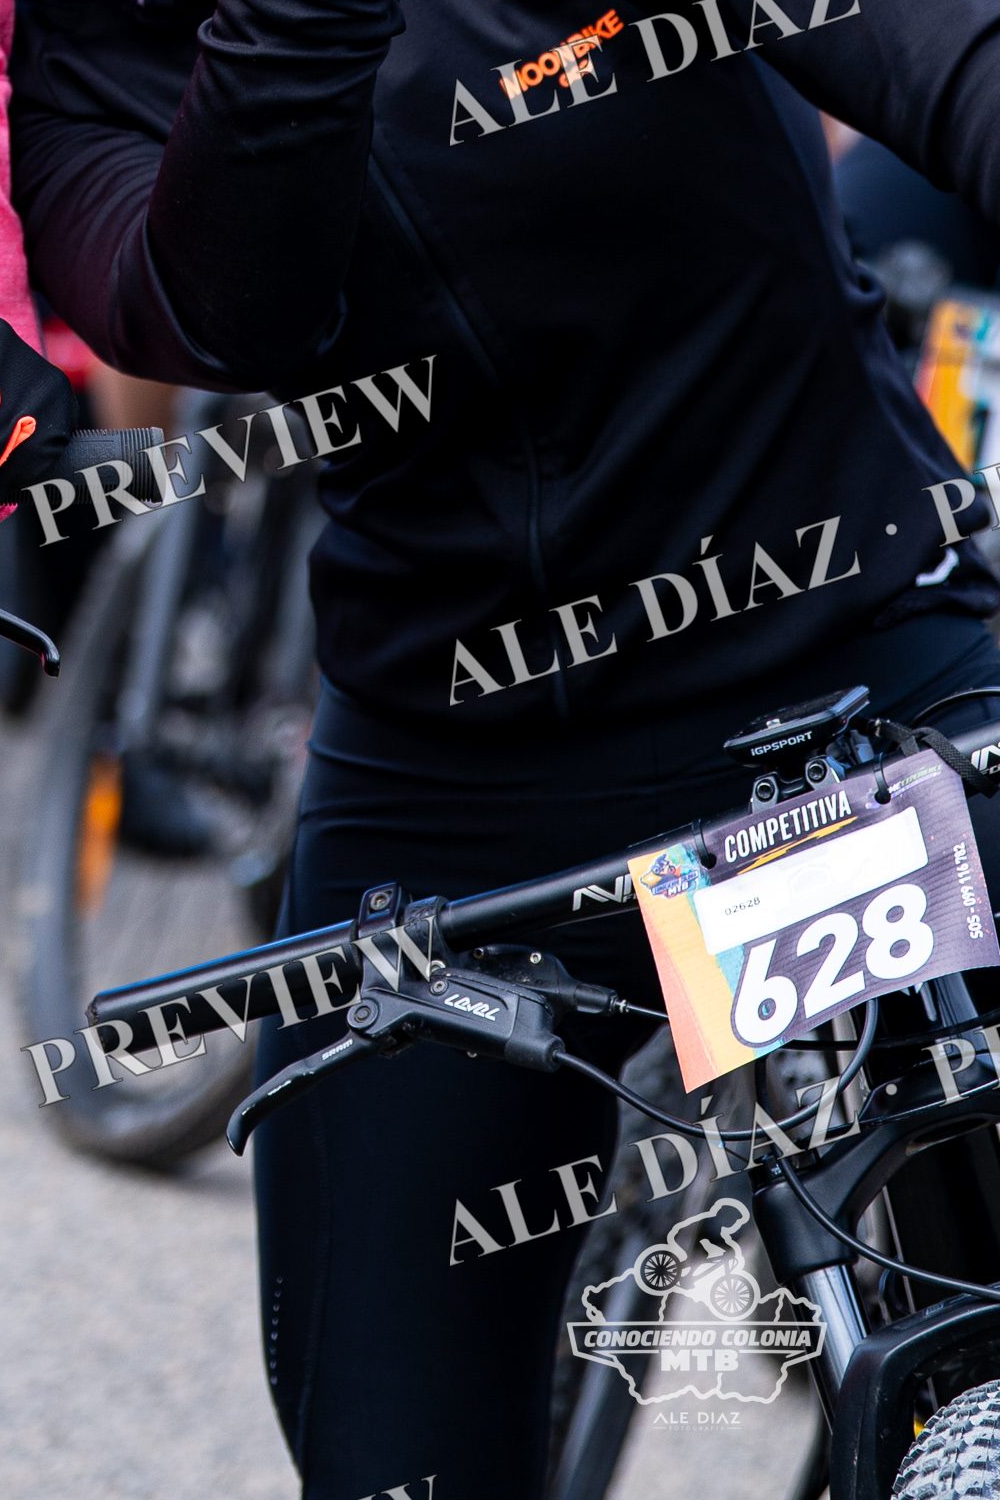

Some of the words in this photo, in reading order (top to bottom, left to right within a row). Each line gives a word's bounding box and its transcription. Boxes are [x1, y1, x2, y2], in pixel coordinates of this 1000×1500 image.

[723, 790, 851, 863] COMPETITIVA
[724, 896, 761, 916] 02628
[961, 886, 976, 907] 099
[967, 914, 984, 939] SOS
[733, 883, 935, 1045] 628
